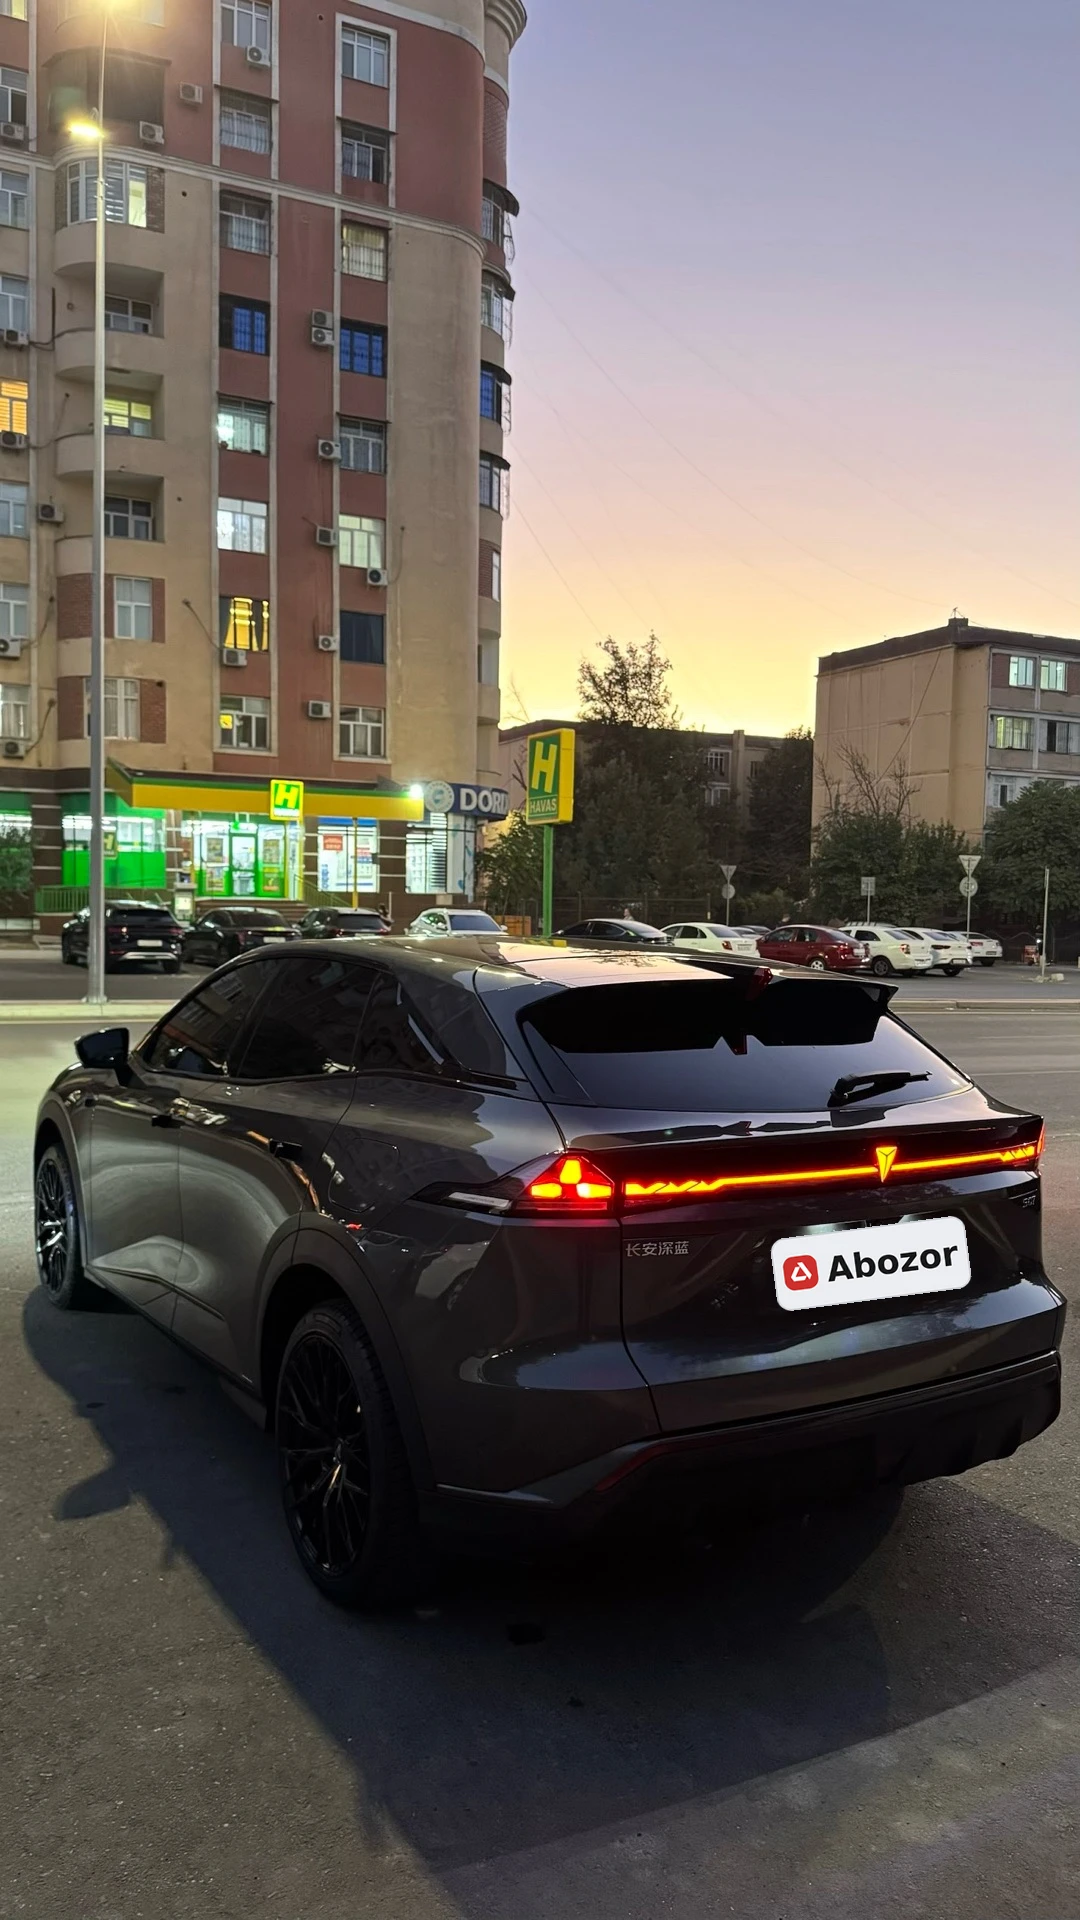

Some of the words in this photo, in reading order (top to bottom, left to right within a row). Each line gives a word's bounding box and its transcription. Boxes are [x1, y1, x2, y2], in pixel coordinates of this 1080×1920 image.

[531, 740, 558, 794] H
[274, 783, 299, 809] H
[530, 798, 557, 814] HAVAS
[625, 1240, 689, 1257] 长安深蓝
